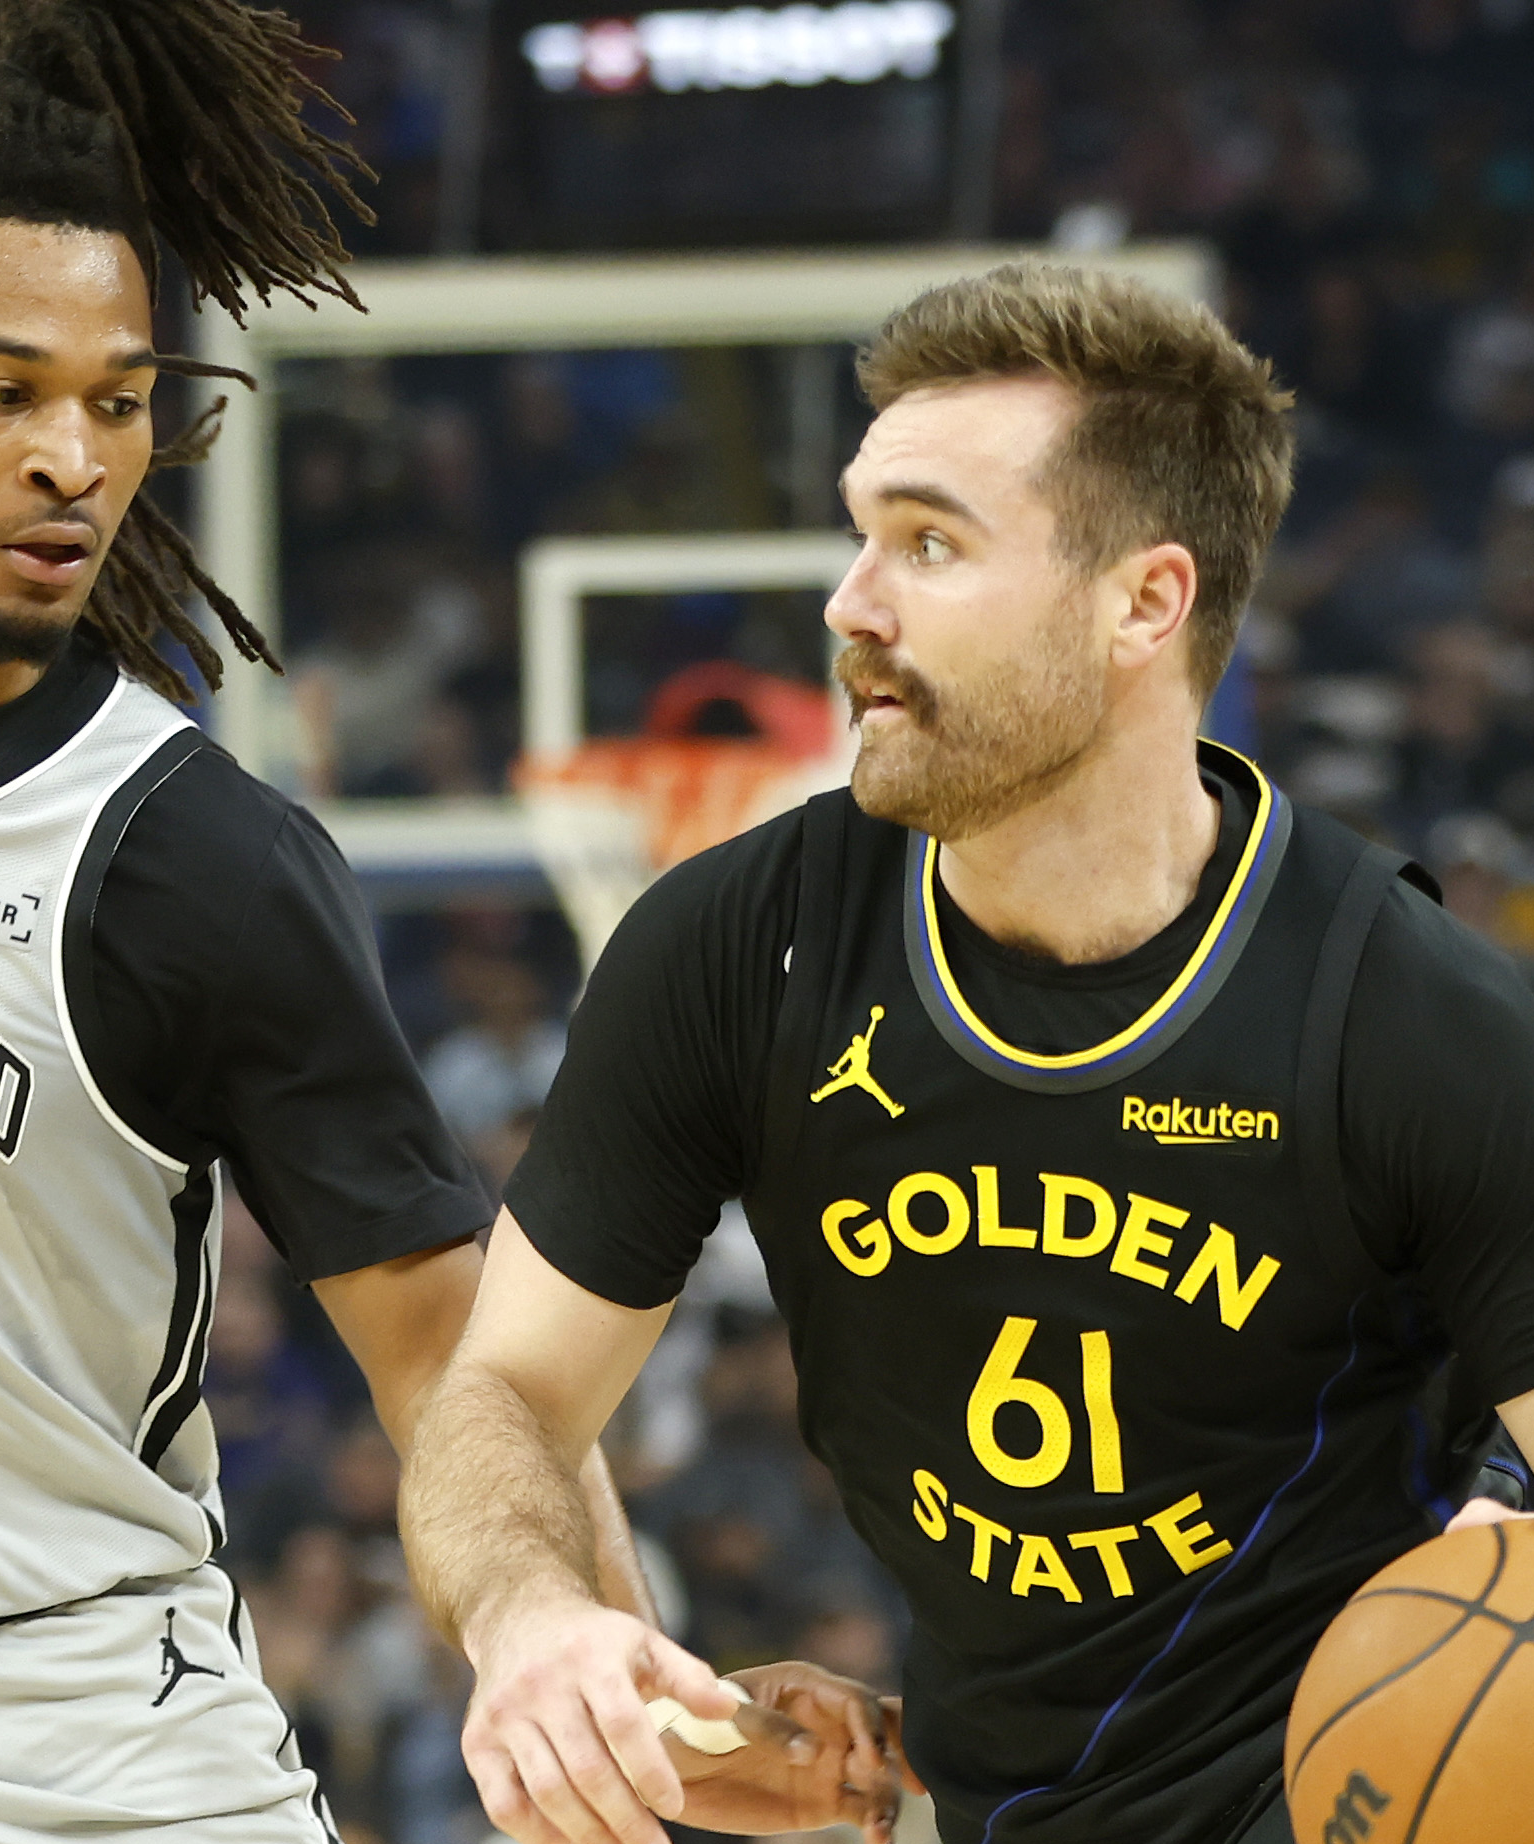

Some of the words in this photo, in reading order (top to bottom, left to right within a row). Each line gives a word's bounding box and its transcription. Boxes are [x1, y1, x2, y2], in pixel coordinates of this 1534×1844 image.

[1122, 1095, 1279, 1141] Rakuten
[820, 1165, 1281, 1331] GOLDEN
[967, 1316, 1125, 1493] 61
[912, 1469, 1234, 1603] STATE
